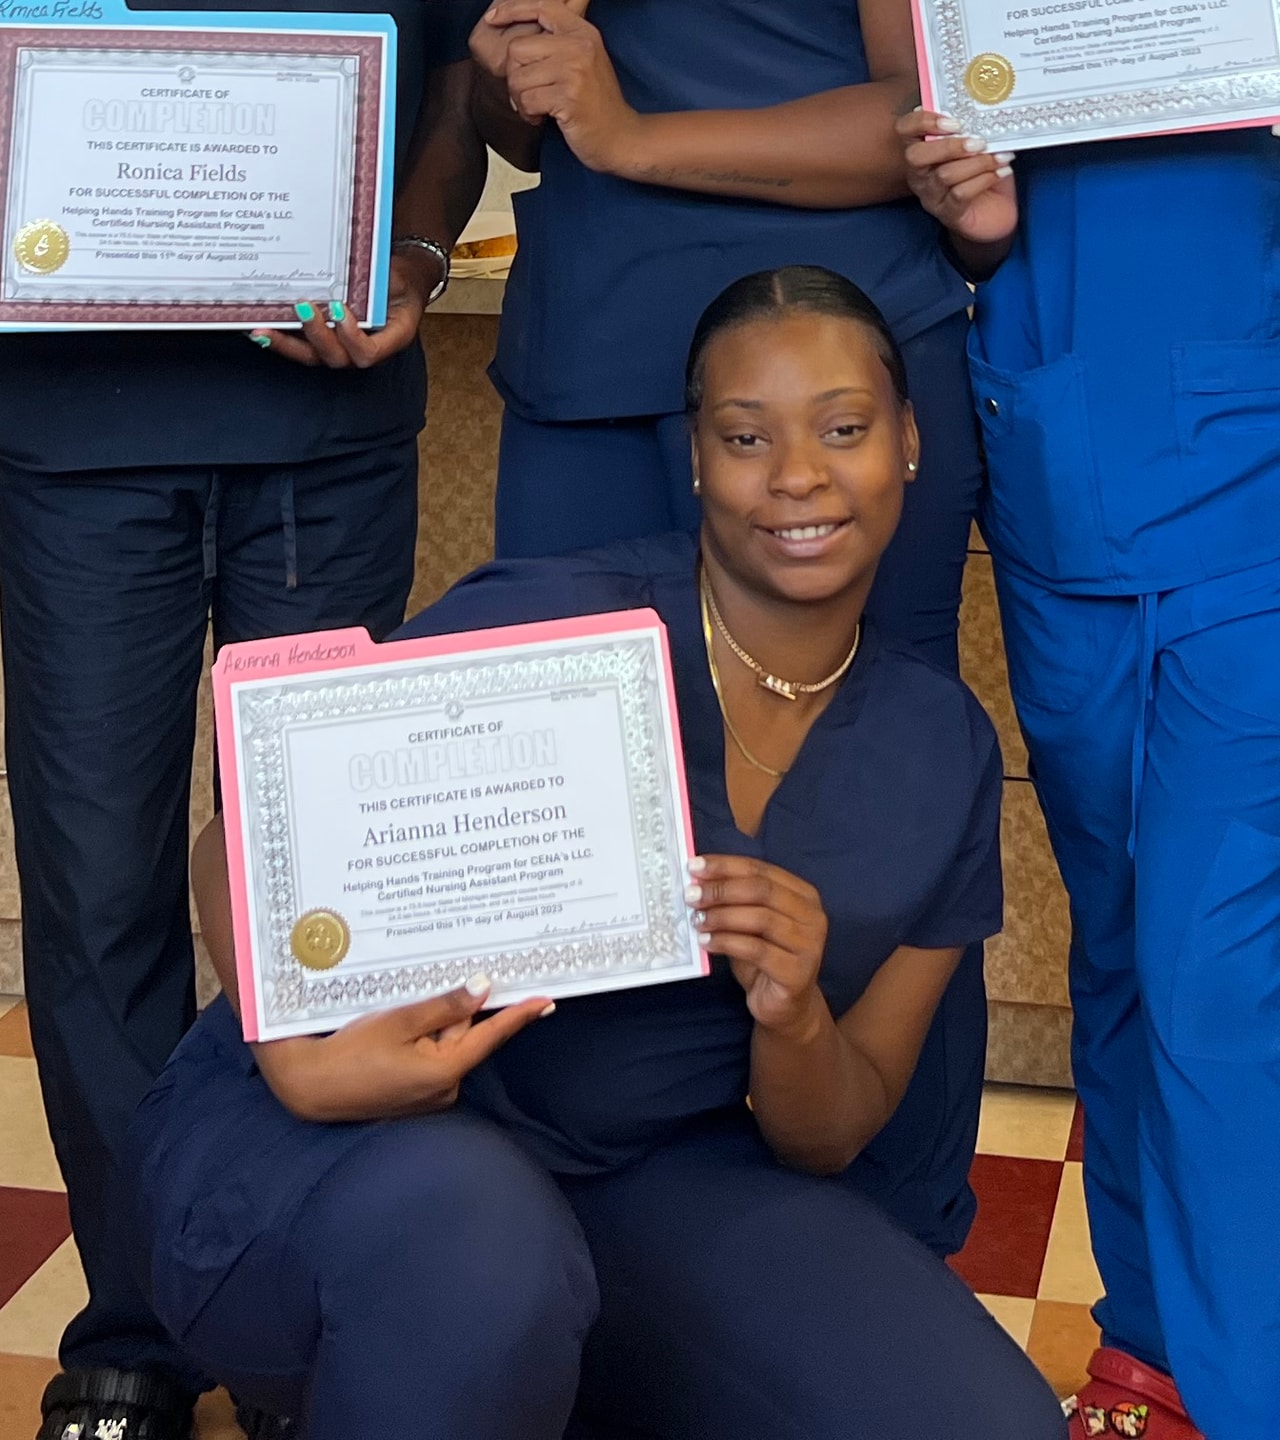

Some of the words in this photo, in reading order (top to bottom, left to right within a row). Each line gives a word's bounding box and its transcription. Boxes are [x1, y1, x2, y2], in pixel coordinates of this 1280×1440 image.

[51, 0, 104, 20] Fields
[140, 88, 212, 99] CERTIFICATE
[213, 89, 230, 99] OF
[83, 99, 276, 136] COMPLETION
[116, 162, 183, 180] Ronica
[189, 163, 247, 182] Fields
[407, 723, 485, 744] CERTIFICATE
[487, 720, 503, 733] OF
[348, 728, 557, 792] COMPLETION
[358, 799, 387, 814] THIS
[389, 788, 467, 809] CERTIFICATE
[470, 786, 482, 798] IS
[484, 777, 546, 796] AWARDED
[547, 775, 564, 787] TO
[362, 822, 447, 847] Arianna
[453, 805, 567, 834] Henderson
[347, 857, 373, 872] FOR
[375, 845, 458, 867] SUCCESSFUL
[460, 834, 540, 855] COMPLETION
[542, 831, 558, 843] OF
[561, 827, 585, 840] THE
